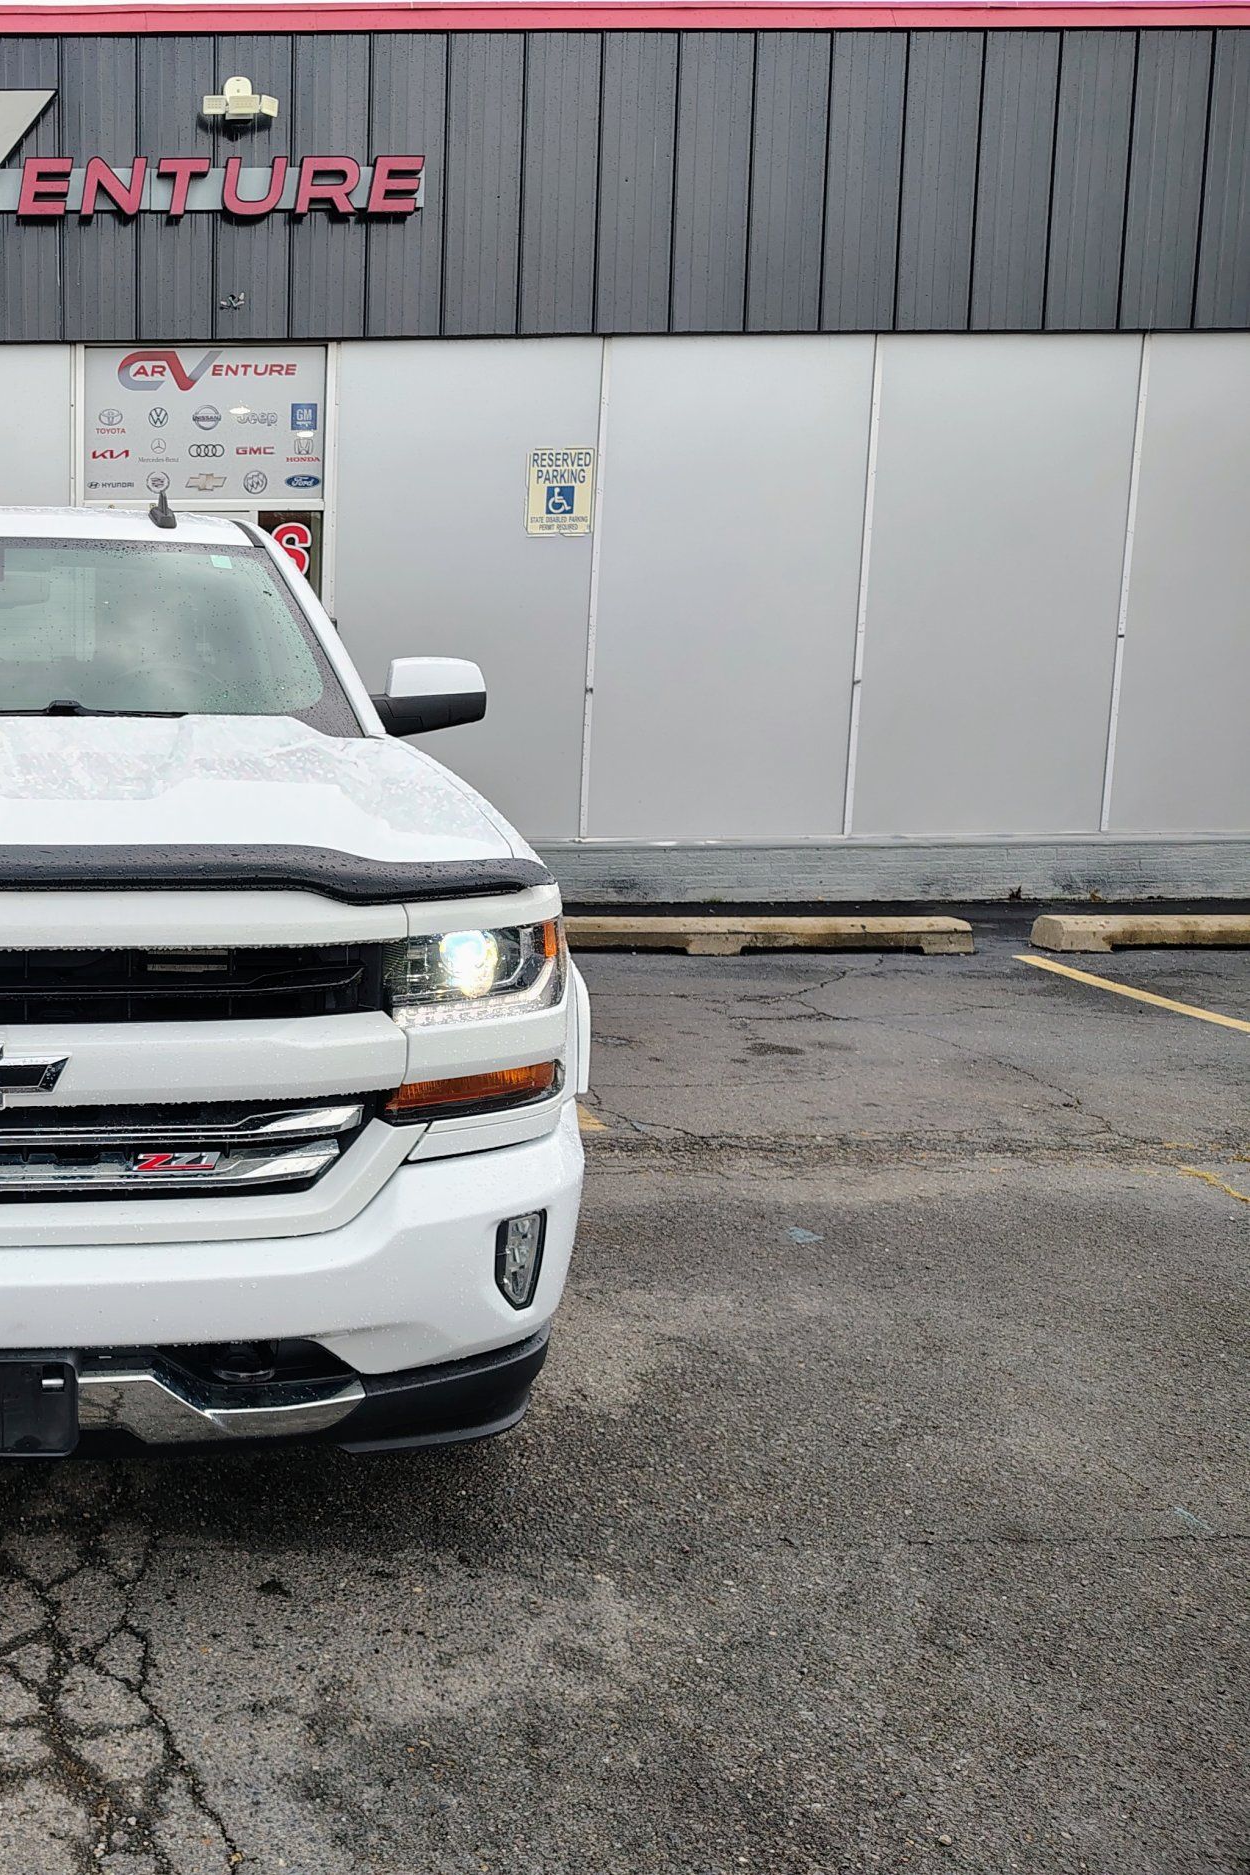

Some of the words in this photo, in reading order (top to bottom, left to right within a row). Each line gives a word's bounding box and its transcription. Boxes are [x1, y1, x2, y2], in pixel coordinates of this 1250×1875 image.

[296, 408, 312, 421] GM
[235, 446, 275, 455] GMC
[532, 452, 591, 468] RESERVED
[291, 478, 314, 487] Ford
[536, 469, 586, 484] PARKING
[133, 1151, 221, 1172] Z71
